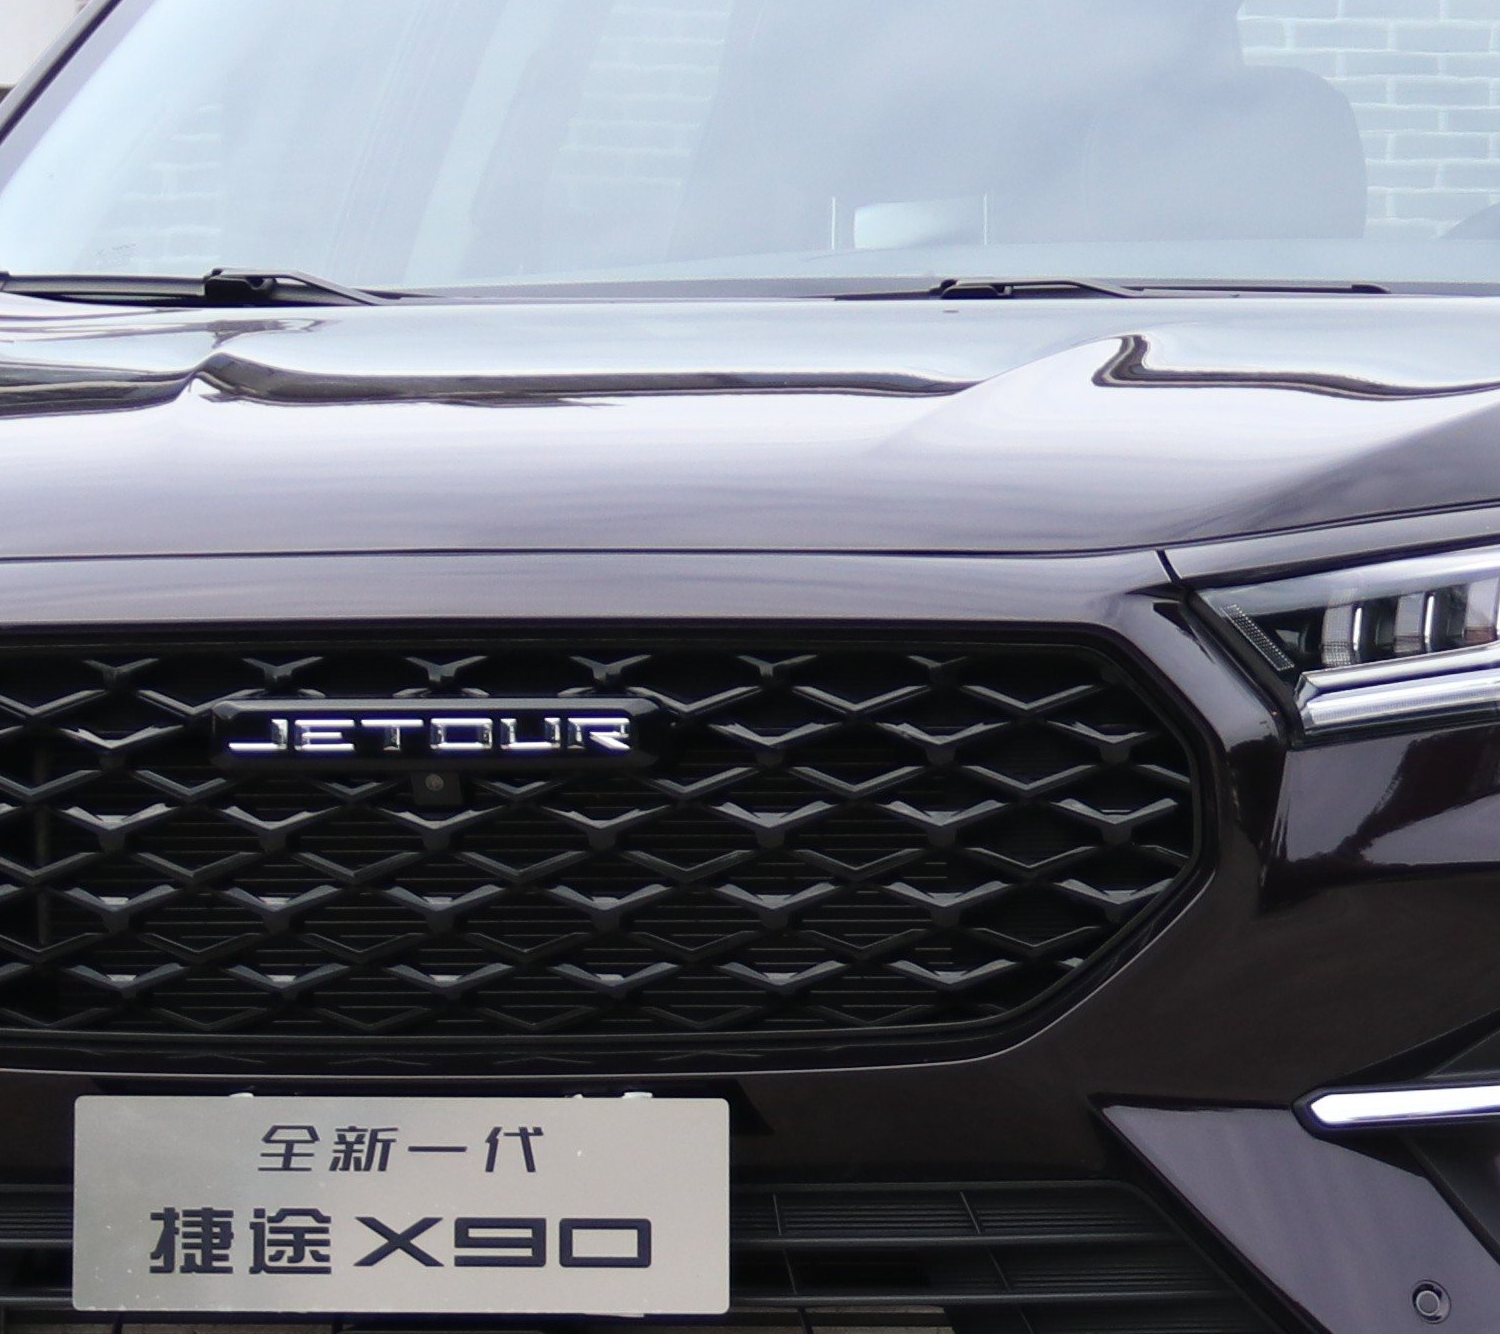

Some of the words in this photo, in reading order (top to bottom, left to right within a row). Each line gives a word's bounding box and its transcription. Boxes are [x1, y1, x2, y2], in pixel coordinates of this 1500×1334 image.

[228, 716, 633, 754] JETOUR
[257, 1124, 546, 1174] 全新一代
[149, 1206, 653, 1276] 捷途X90
